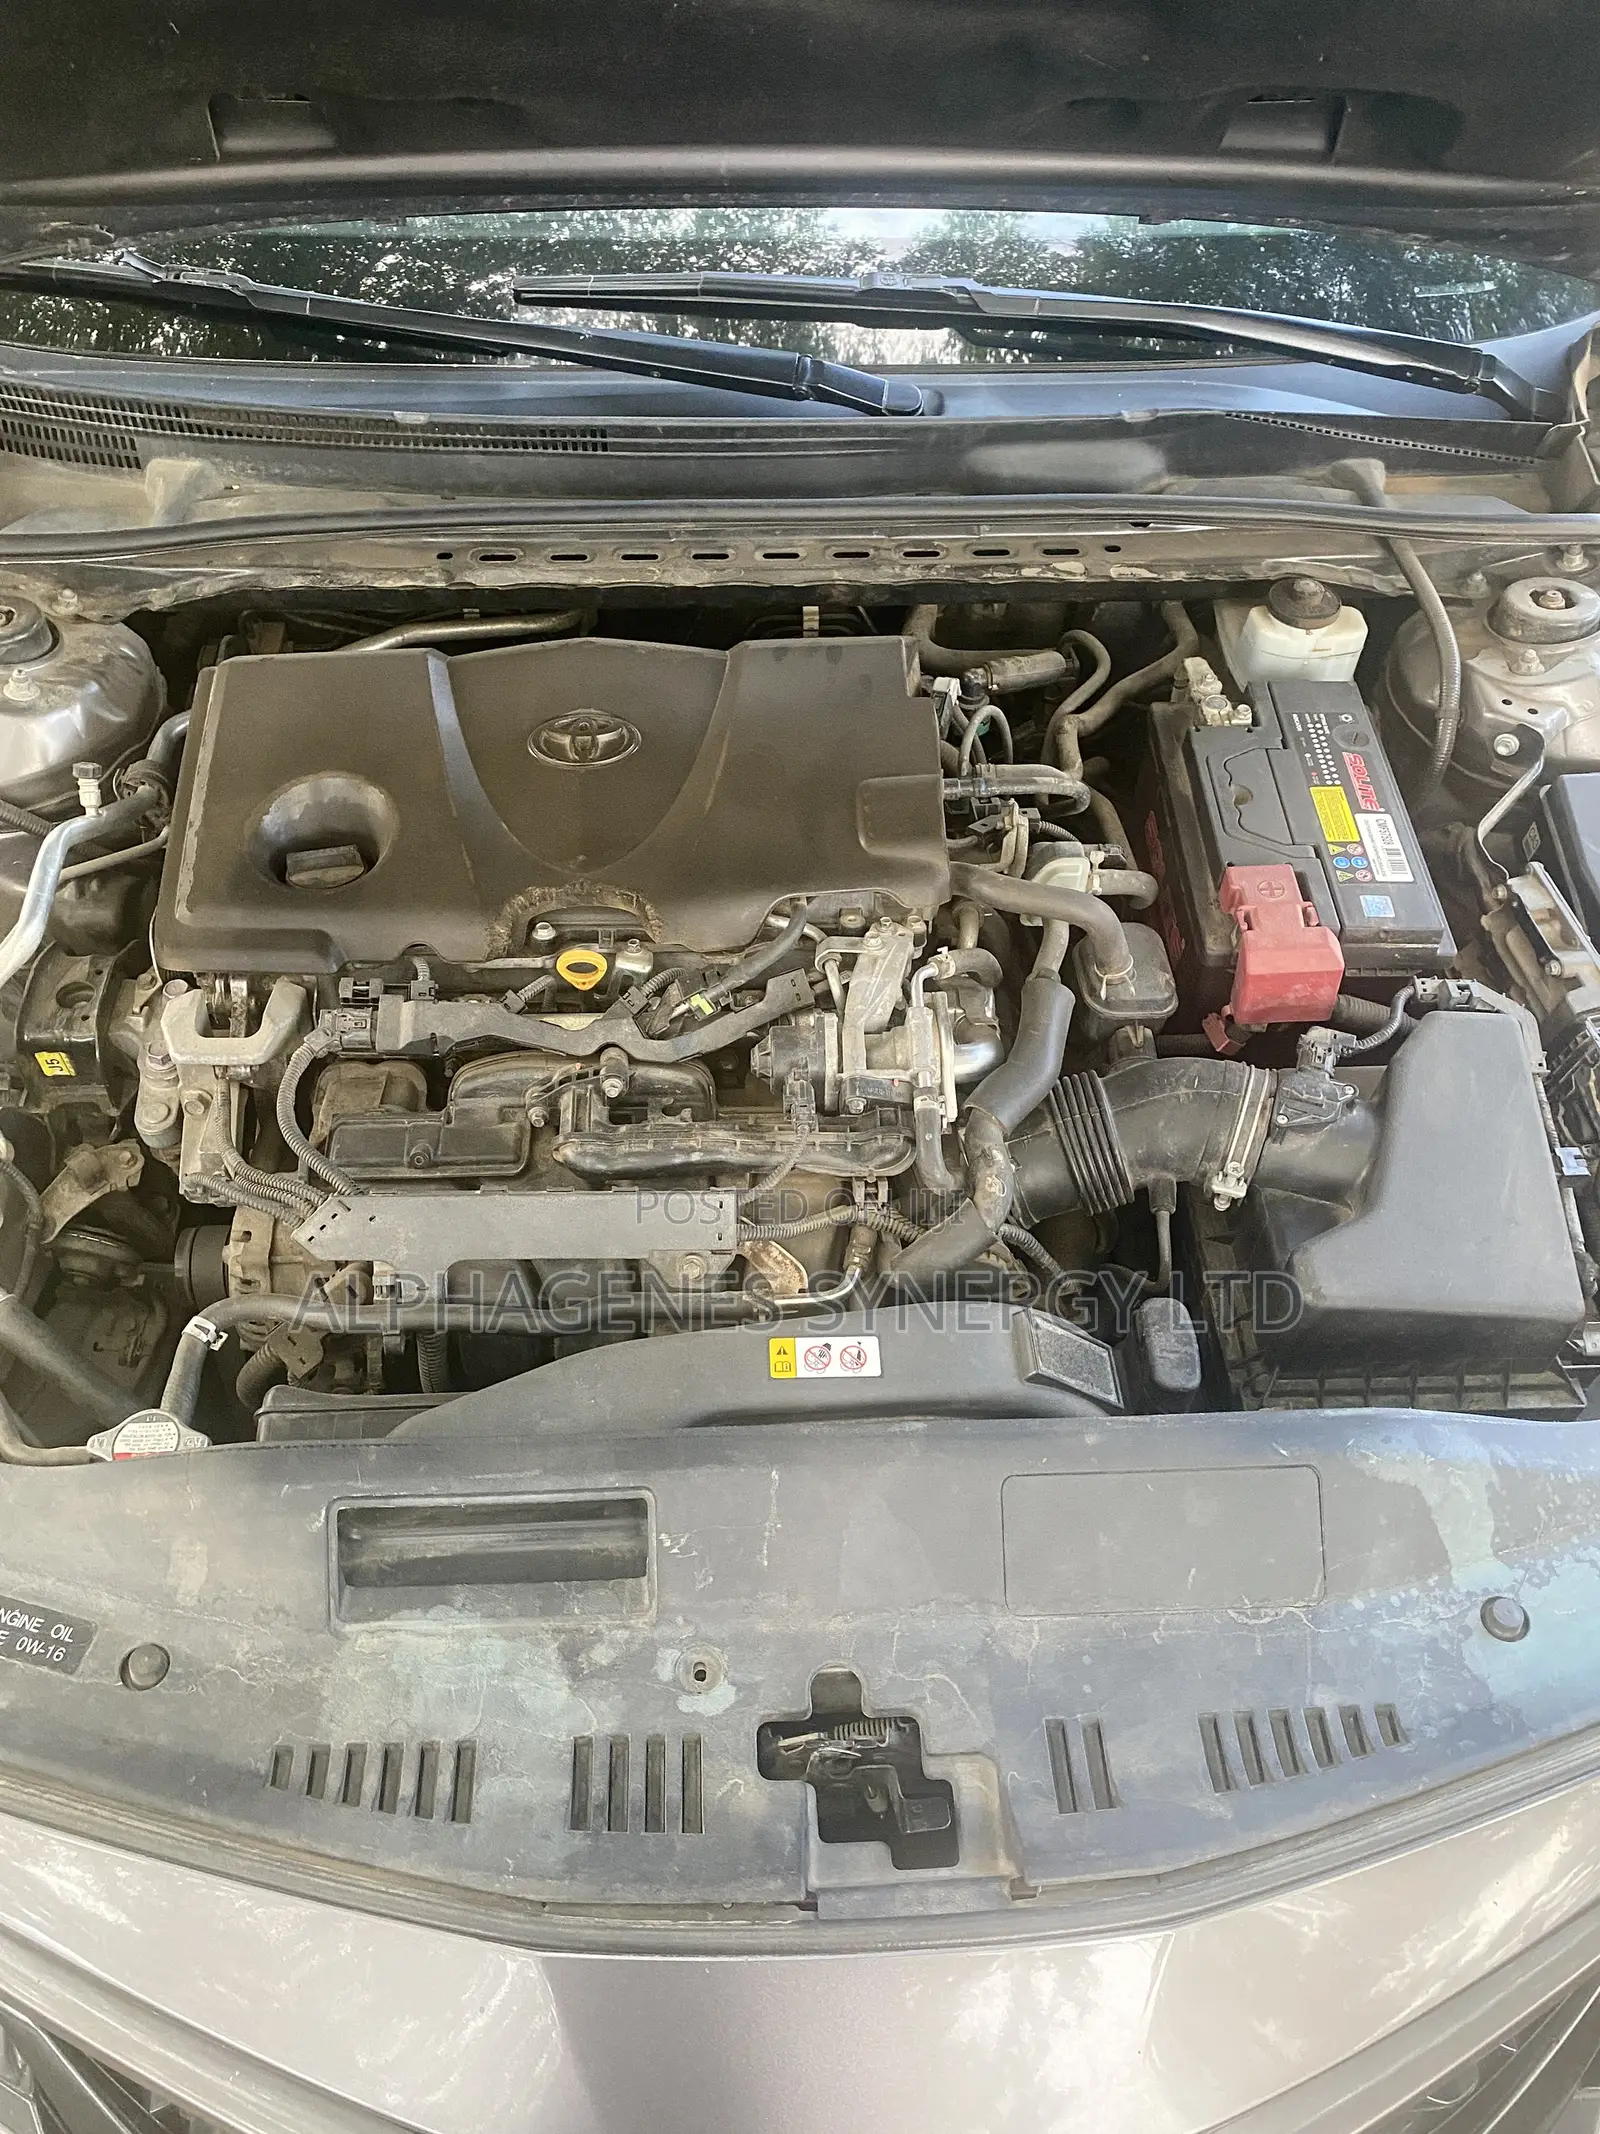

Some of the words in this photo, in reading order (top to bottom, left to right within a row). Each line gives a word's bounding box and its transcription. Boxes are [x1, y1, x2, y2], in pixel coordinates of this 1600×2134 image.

[1342, 751, 1381, 811] SOLITE
[50, 1624, 74, 1643] OIL
[16, 1636, 66, 1662] 0W-16
